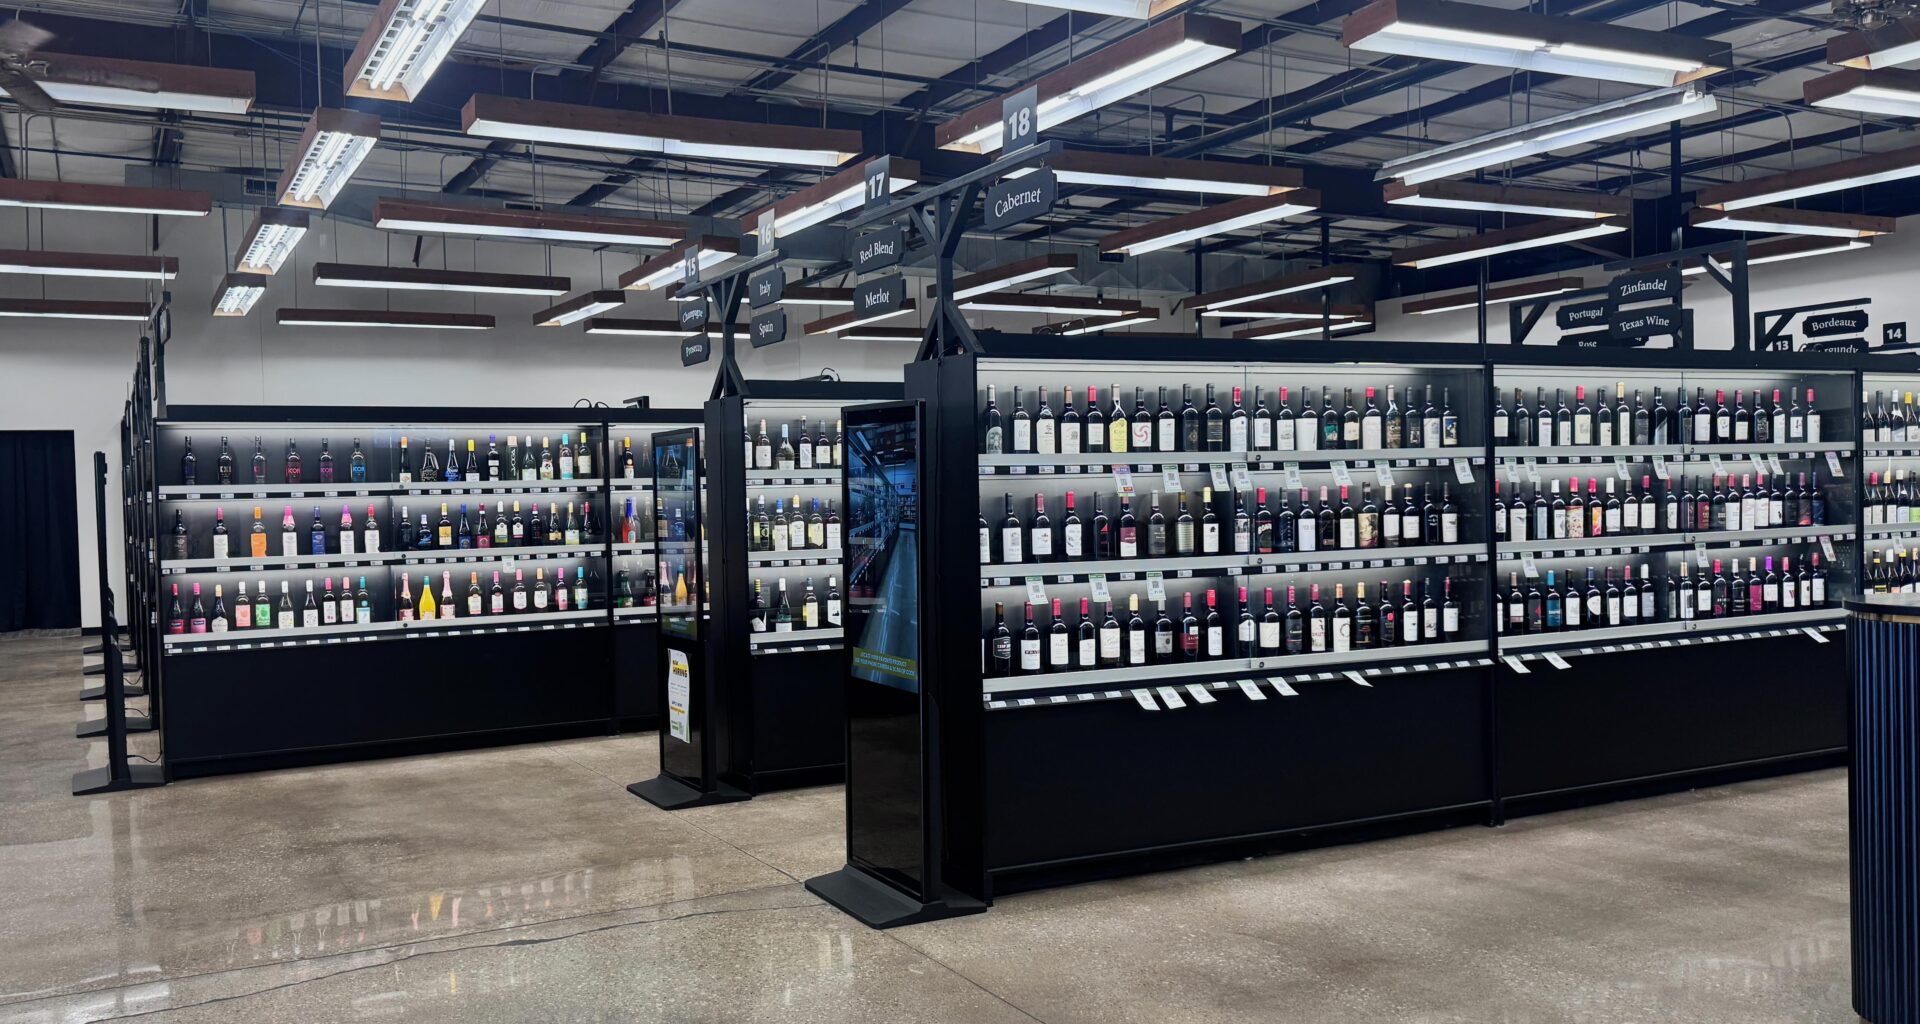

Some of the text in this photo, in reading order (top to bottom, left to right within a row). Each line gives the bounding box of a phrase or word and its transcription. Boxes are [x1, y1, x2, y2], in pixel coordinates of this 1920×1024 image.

[1009, 107, 1030, 140] 18
[868, 172, 885, 200] 17
[995, 188, 1041, 218] Cabernet
[760, 224, 772, 246] 16
[860, 241, 894, 263] Red Blend
[687, 257, 696, 277] 15
[759, 280, 772, 296] Italy
[1620, 279, 1667, 296] Zinfandel
[865, 288, 890, 308] Merlot
[682, 309, 704, 322] Champagne
[1569, 307, 1604, 321] Portugal
[759, 320, 773, 338] Spain
[1620, 315, 1670, 332] Texas Wine
[1812, 318, 1857, 331] Bordeaux
[1887, 328, 1902, 340] 14
[1776, 341, 1789, 350] 13
